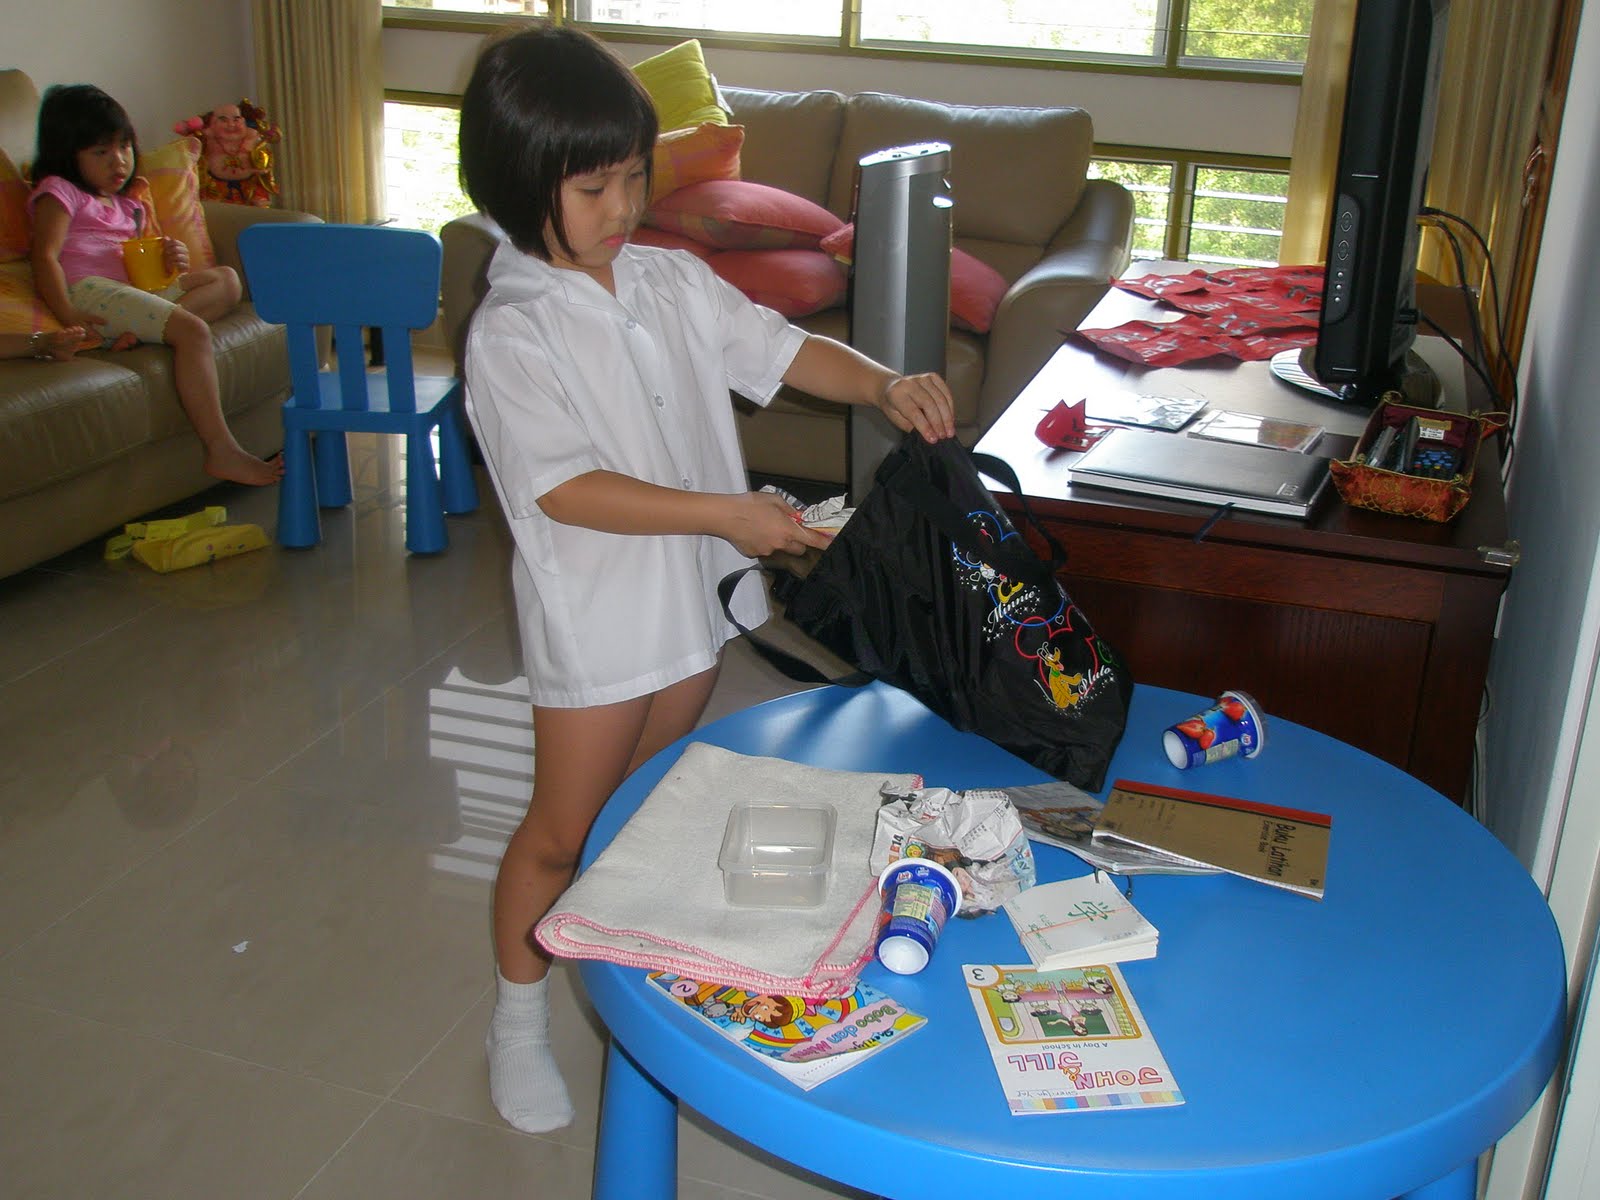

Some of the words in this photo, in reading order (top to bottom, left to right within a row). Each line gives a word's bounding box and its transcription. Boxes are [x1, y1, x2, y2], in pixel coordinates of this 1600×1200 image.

[987, 588, 1036, 633] Minnie
[1078, 665, 1112, 698] Pluto
[1273, 823, 1297, 845] Buku
[1267, 846, 1293, 877] Latihan
[971, 968, 986, 981] 3
[677, 984, 692, 993] 2
[855, 1004, 898, 1028] Bobo
[825, 1024, 858, 1045] dan
[1041, 1043, 1071, 1051] School
[1008, 1052, 1083, 1072] JILL
[1073, 1066, 1163, 1090] JOHN
